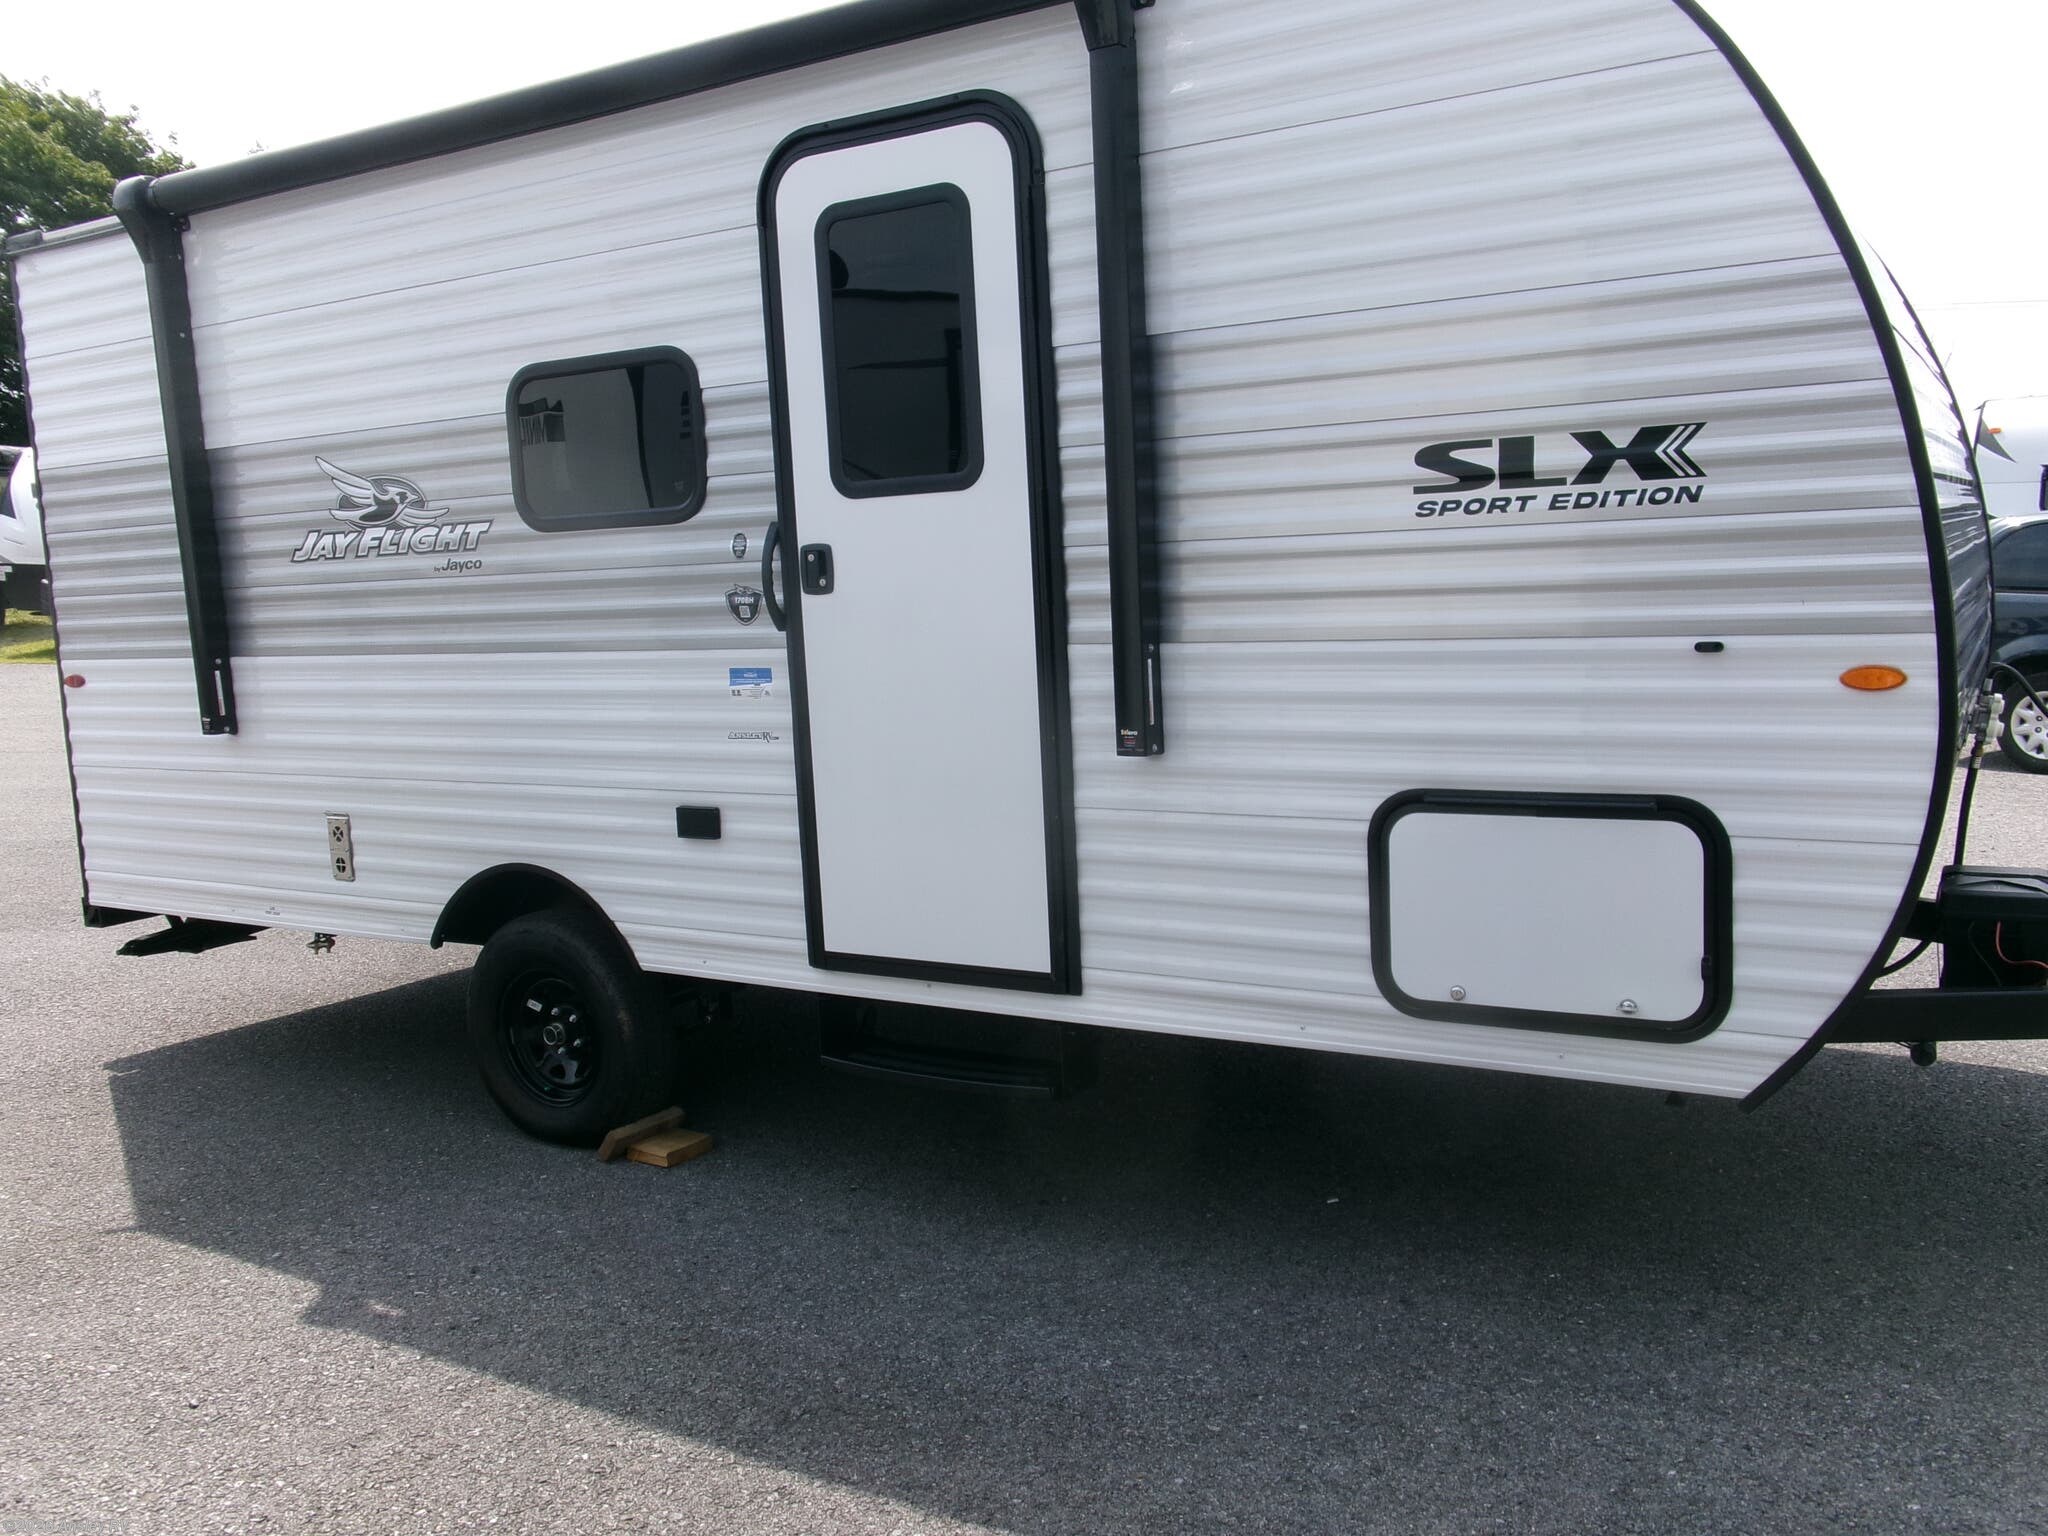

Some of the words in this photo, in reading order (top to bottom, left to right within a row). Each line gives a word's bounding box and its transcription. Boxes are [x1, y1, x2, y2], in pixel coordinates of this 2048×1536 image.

[1413, 422, 1707, 495] SLX
[1415, 495, 1537, 517] SPORT
[1548, 485, 1704, 511] EDITION
[441, 558, 482, 573] Jayco
